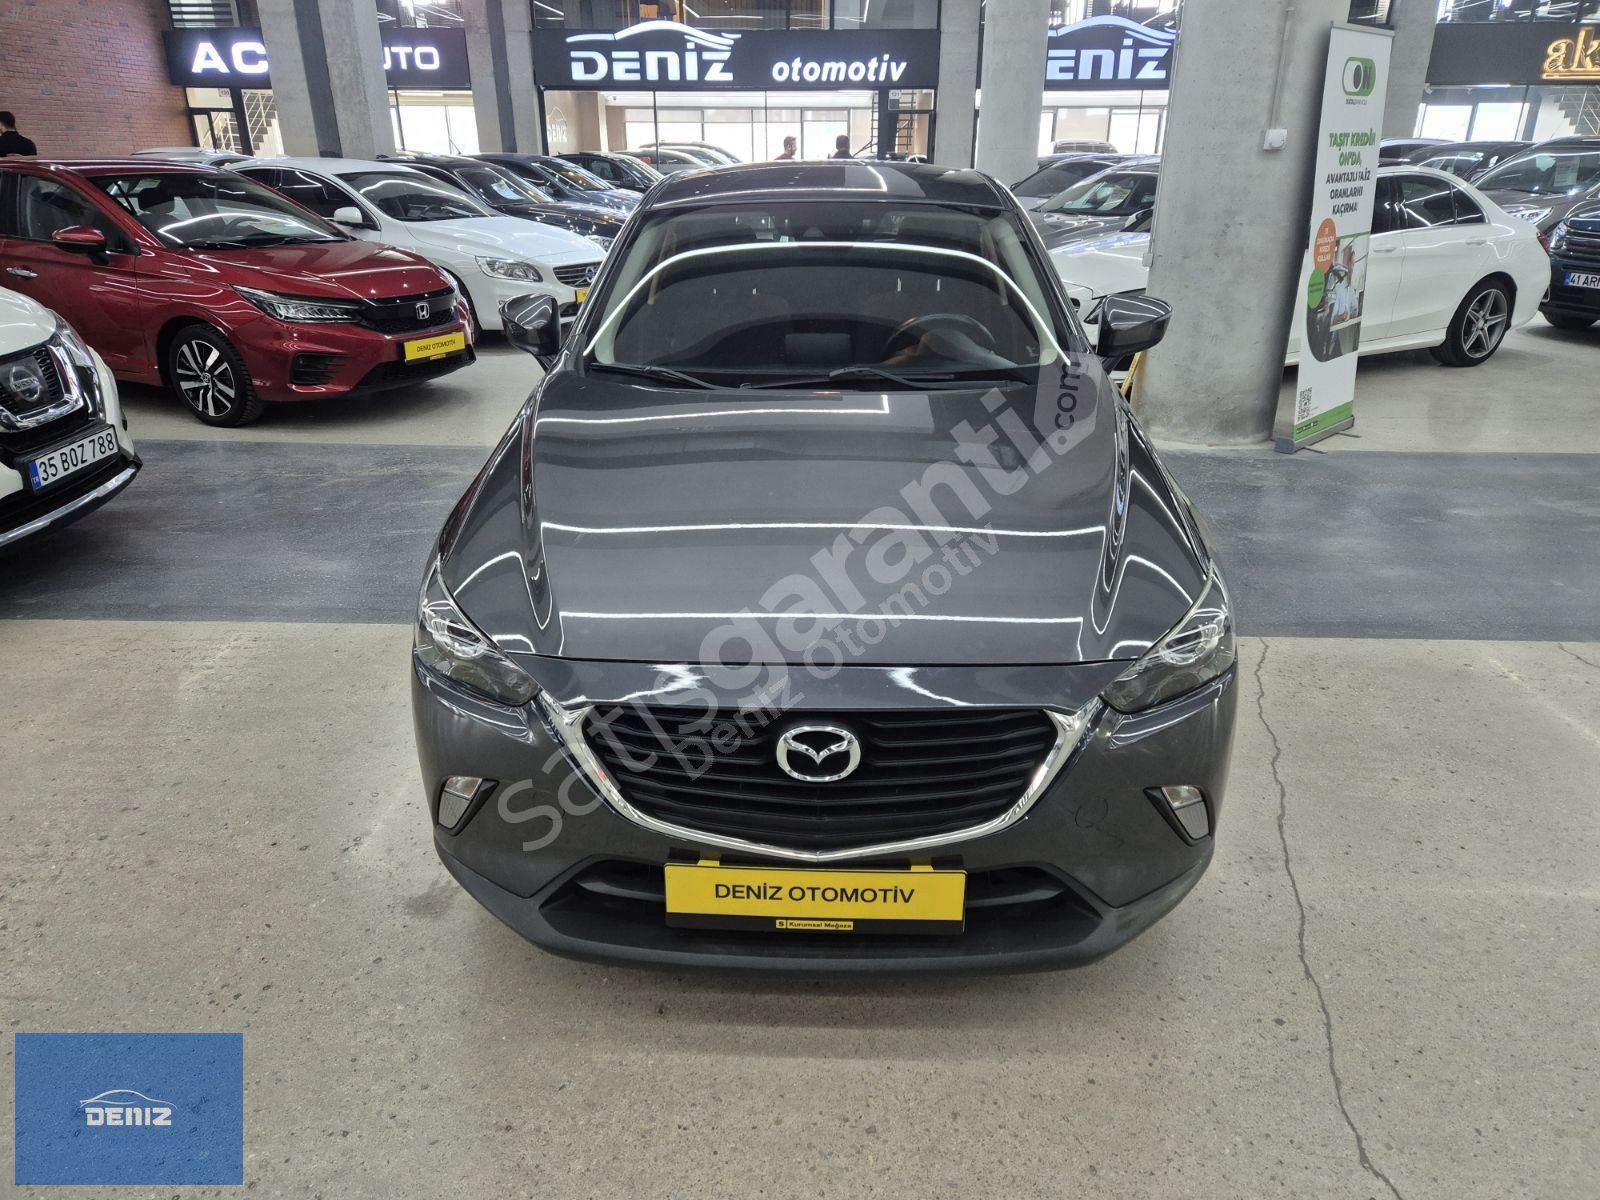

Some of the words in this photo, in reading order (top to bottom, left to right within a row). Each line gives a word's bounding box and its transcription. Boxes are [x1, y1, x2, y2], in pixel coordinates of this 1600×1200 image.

[772, 54, 908, 82] otomotiv
[1046, 38, 1169, 80] ENİZ
[1571, 274, 1581, 285] 41
[39, 456, 58, 482] 35
[60, 443, 88, 472] BOZ
[88, 432, 115, 459] 788
[715, 882, 782, 901] DENİZ
[788, 884, 915, 903] OTOMOTİV
